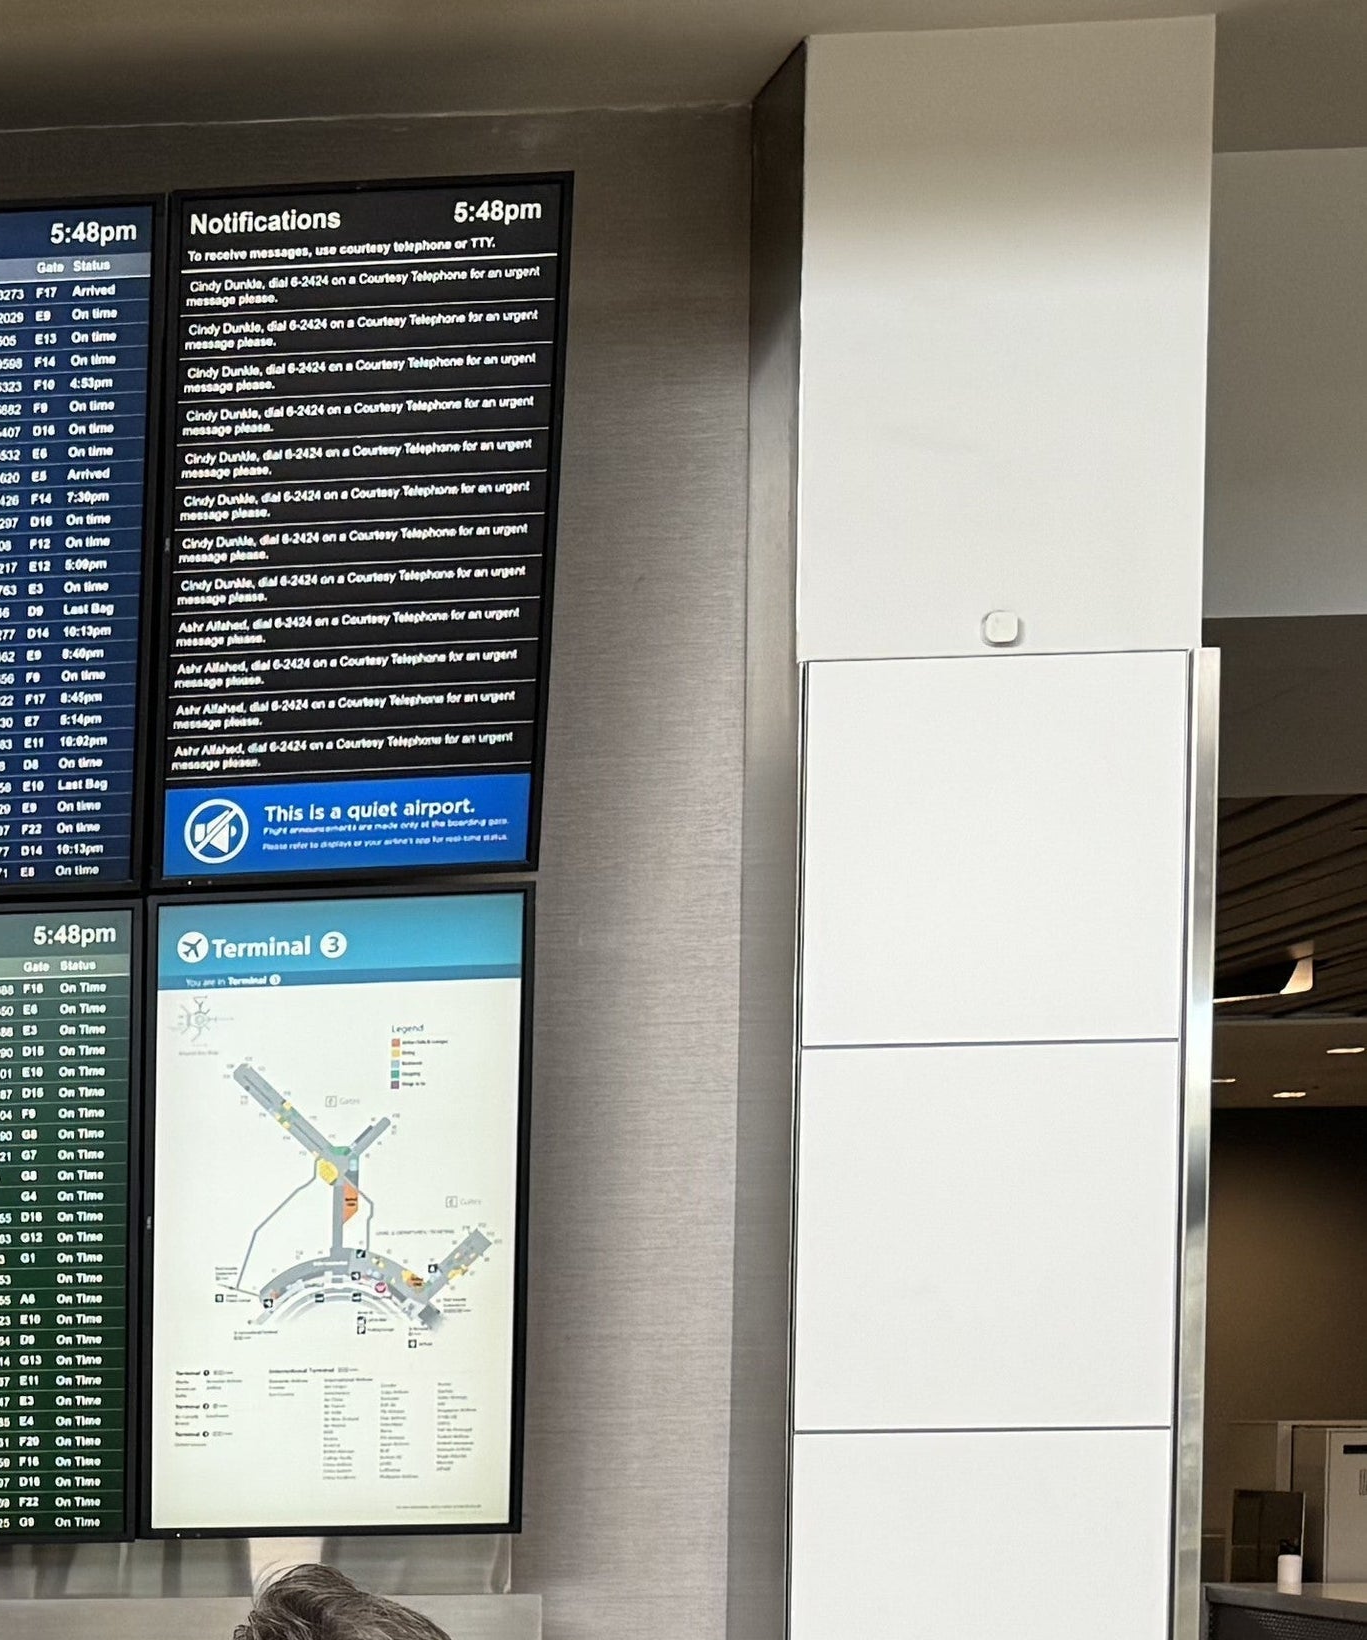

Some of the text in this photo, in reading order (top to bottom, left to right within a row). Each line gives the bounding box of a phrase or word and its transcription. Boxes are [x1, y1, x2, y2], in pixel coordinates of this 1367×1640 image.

[190, 208, 341, 235] Notifications
[453, 199, 542, 226] 5:48pm
[50, 221, 137, 247] 5:48pm
[36, 261, 65, 274] Gate
[73, 259, 111, 272] Status
[263, 798, 476, 823] This is a quiet airport.
[33, 924, 117, 948] 5:48pm
[211, 934, 311, 959] Terminal
[23, 961, 51, 973] Gate
[60, 960, 97, 971] Status
[391, 1023, 424, 1036] Legend
[75, 1313, 103, 1324] Time
